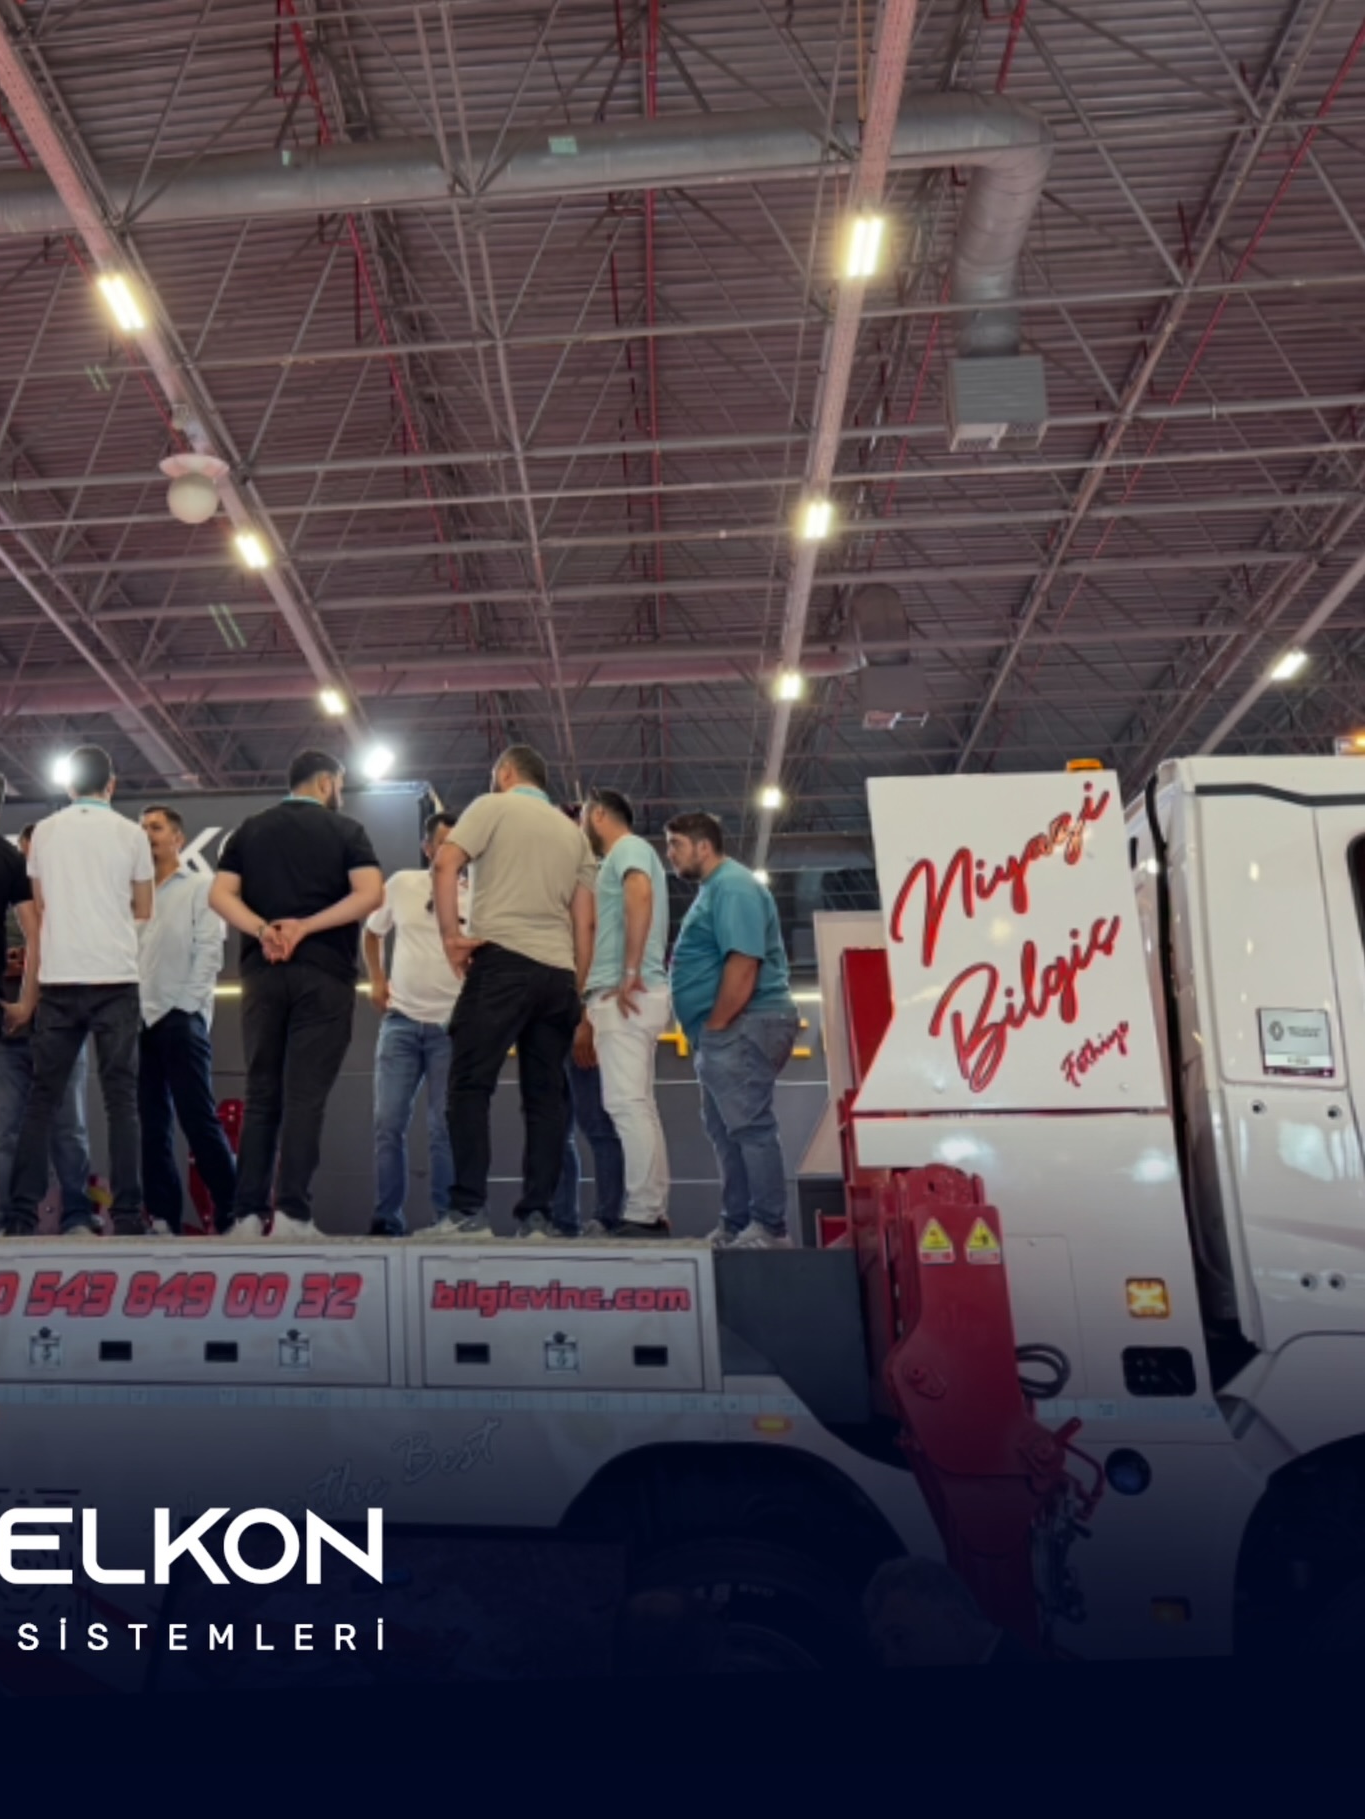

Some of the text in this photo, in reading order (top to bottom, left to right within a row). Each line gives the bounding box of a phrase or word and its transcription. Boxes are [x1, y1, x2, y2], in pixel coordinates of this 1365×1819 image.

[890, 781, 1110, 967] Niyazi
[23, 1270, 117, 1317] 543
[123, 1271, 216, 1318] 849
[222, 1272, 289, 1319] 00
[295, 1272, 363, 1320] 32
[431, 1279, 691, 1317] bilgicvinc.com
[391, 1417, 502, 1486] Best
